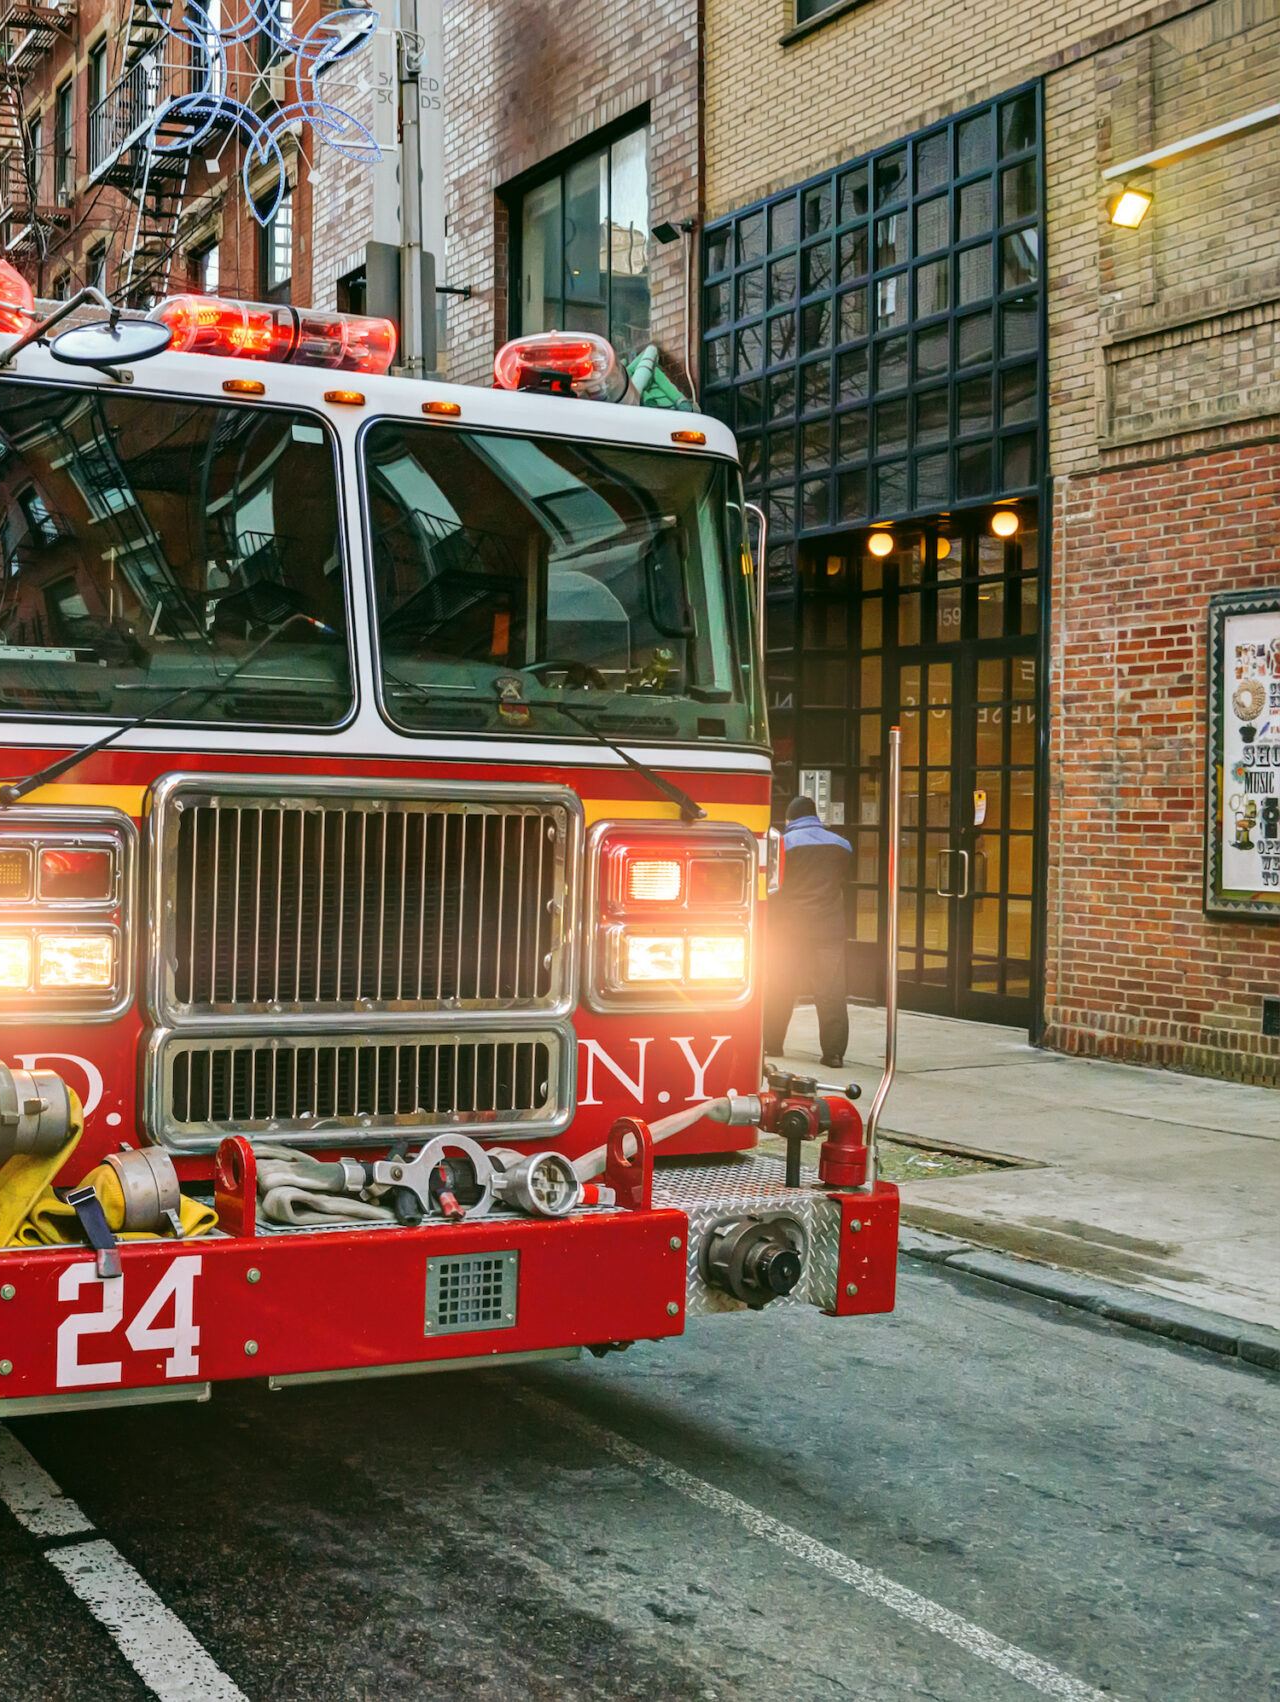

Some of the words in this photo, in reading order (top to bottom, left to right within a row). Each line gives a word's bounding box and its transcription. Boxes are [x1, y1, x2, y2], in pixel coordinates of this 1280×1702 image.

[1245, 771, 1275, 794] MUSIC
[577, 1035, 738, 1105] N.Y.
[56, 1255, 202, 1387] 24
